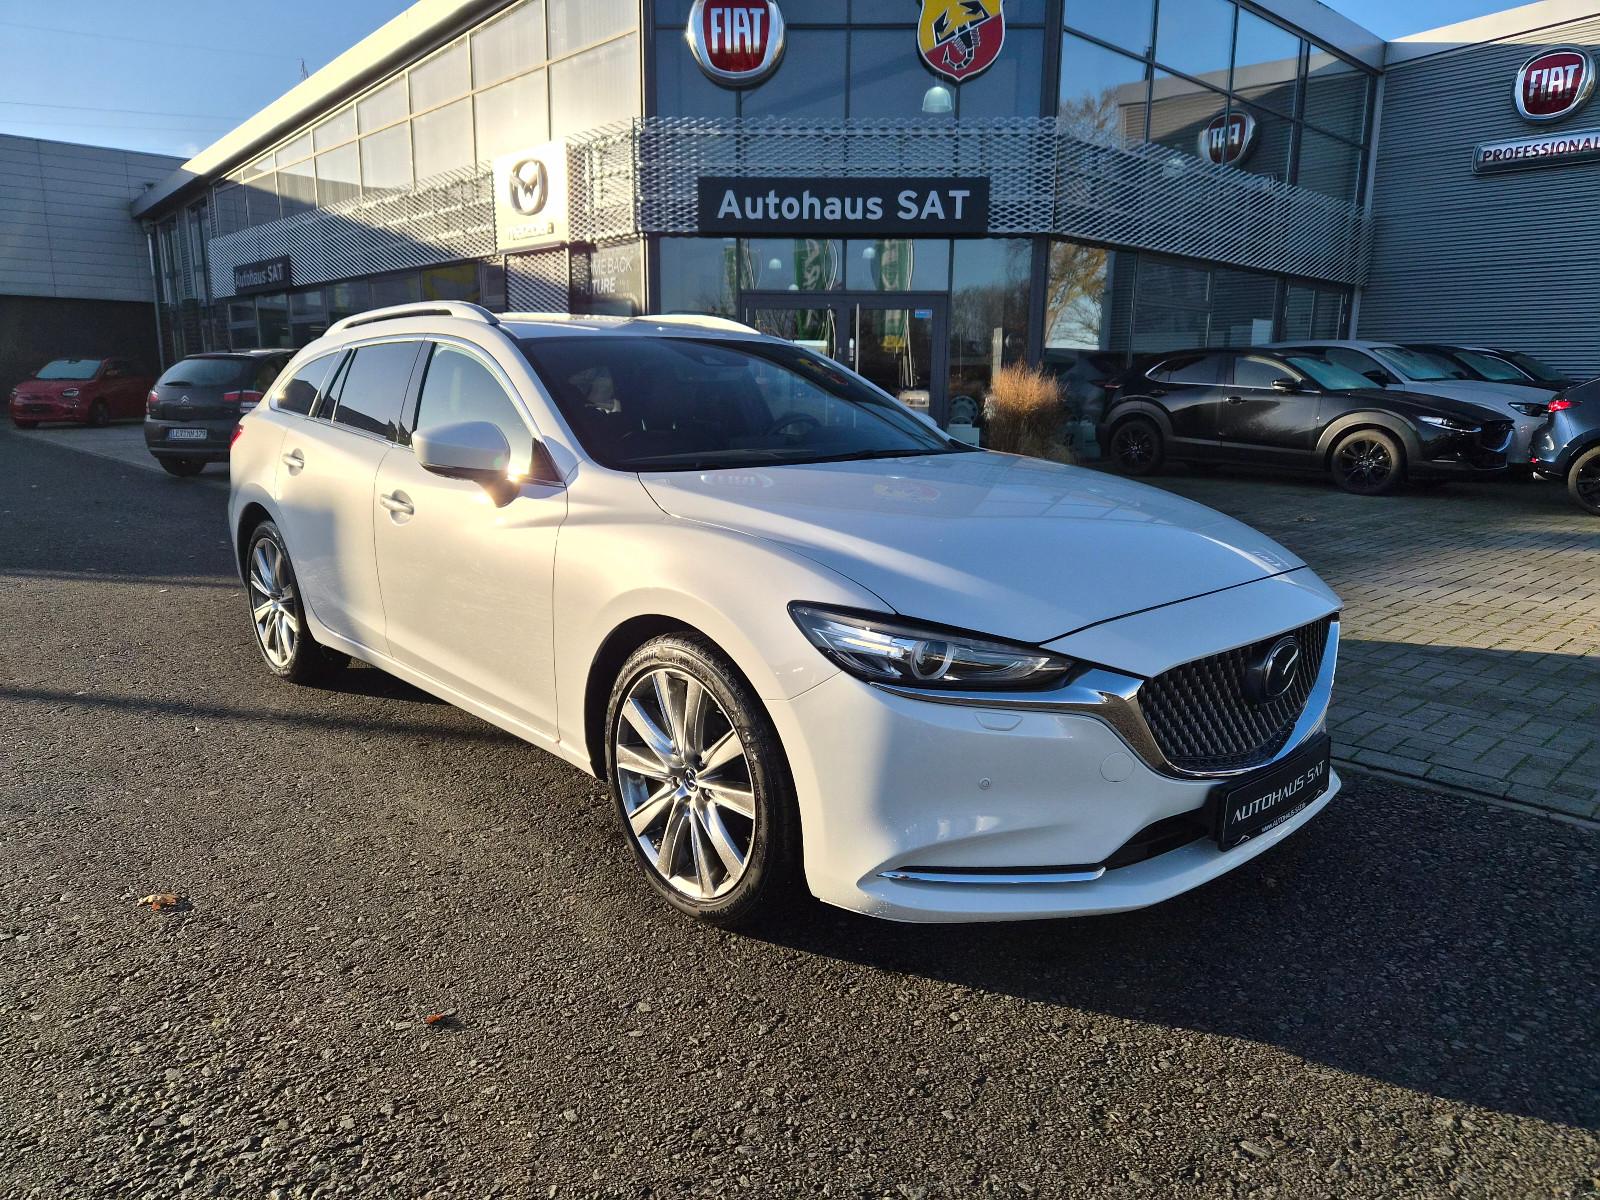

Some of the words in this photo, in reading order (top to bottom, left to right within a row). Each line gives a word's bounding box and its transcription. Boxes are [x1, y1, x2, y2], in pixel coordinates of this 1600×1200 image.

[711, 8, 764, 54] FIAT
[1528, 64, 1579, 103] FIAT
[1482, 136, 1600, 162] PROFESSIONAL
[717, 189, 883, 220] Autohaus
[896, 190, 971, 220] SAT
[235, 270, 266, 288] Autohaus
[267, 263, 283, 282] SAT
[1232, 775, 1305, 824] AUTOHAUS
[1307, 760, 1325, 784] SAT
